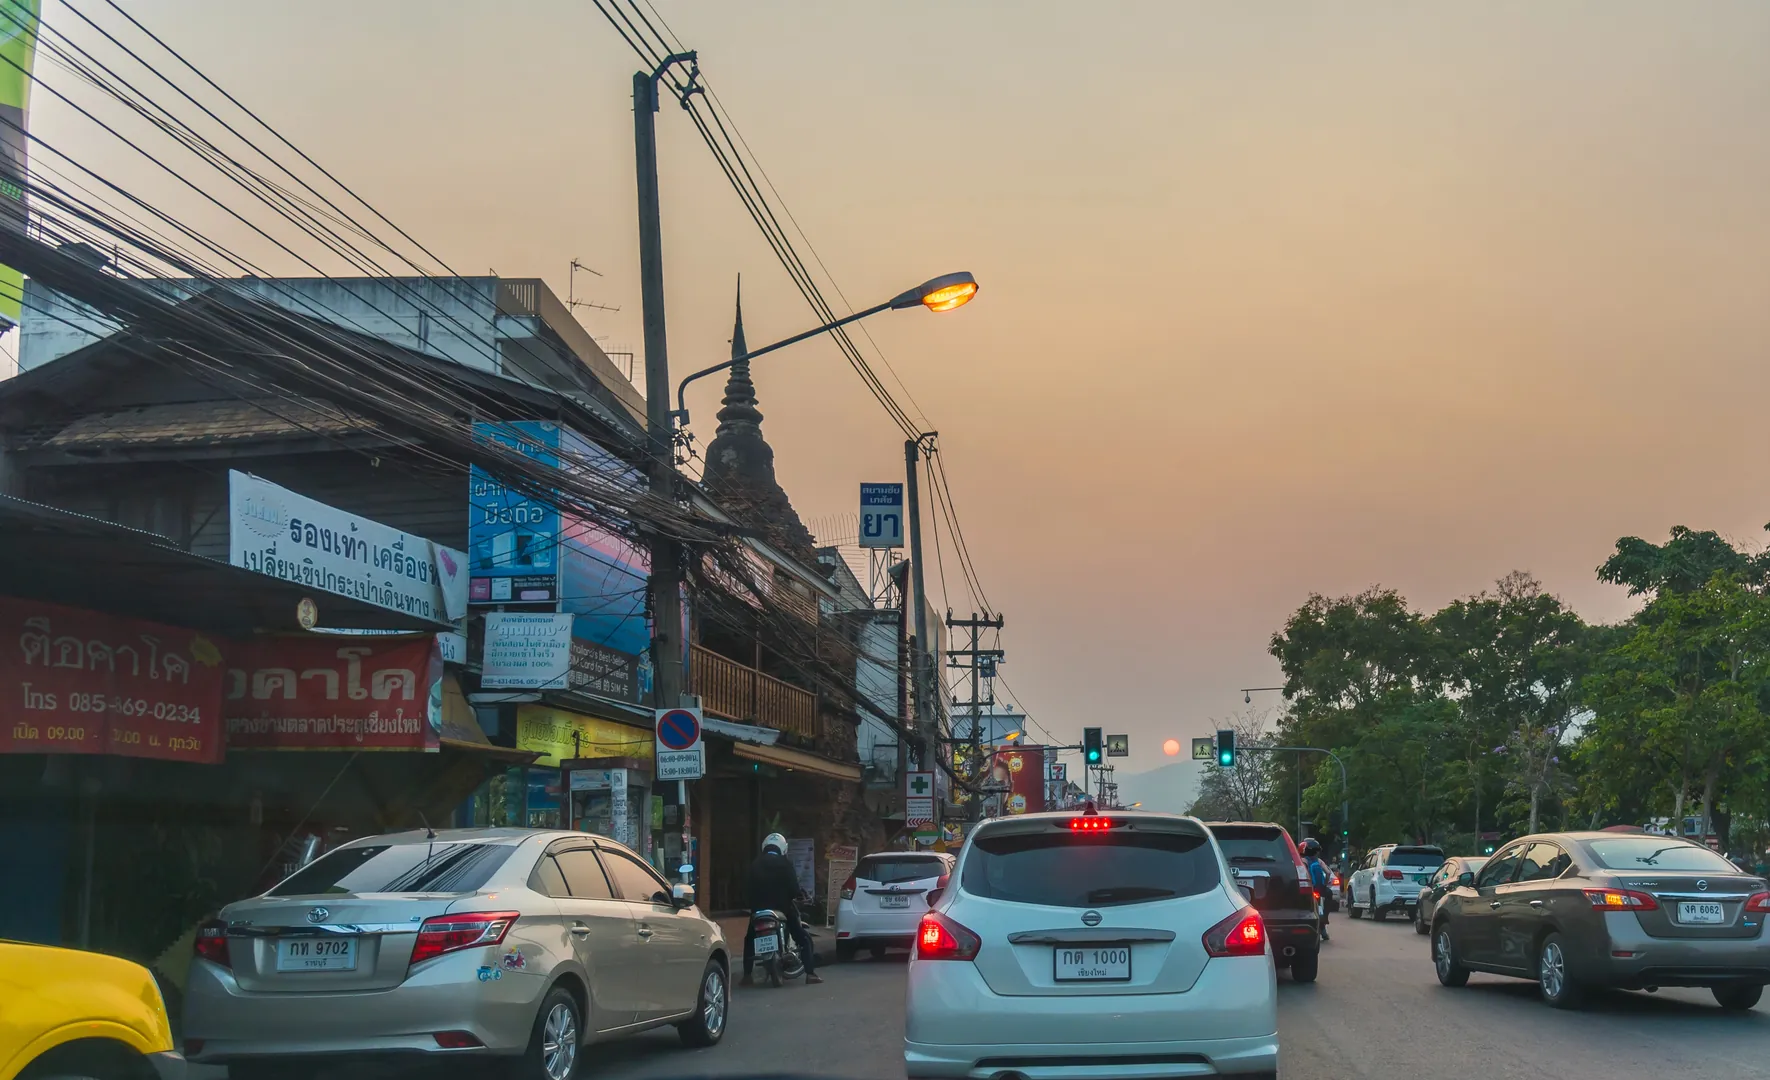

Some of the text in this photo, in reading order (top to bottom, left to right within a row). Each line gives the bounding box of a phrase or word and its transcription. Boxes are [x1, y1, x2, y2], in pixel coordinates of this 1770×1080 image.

[485, 502, 543, 524] มือถือ
[864, 513, 899, 537] ยา
[290, 518, 368, 563] รองเท้า
[22, 682, 57, 710] โทร
[13, 722, 39, 740] เปิด
[47, 726, 85, 741] 09.00
[169, 736, 201, 752] ทุกวัน
[1700, 905, 1719, 914] 6062
[290, 941, 349, 956] กท 9702
[1063, 950, 1127, 965] กต 1000
[1077, 968, 1107, 976] เชียงใหม่
